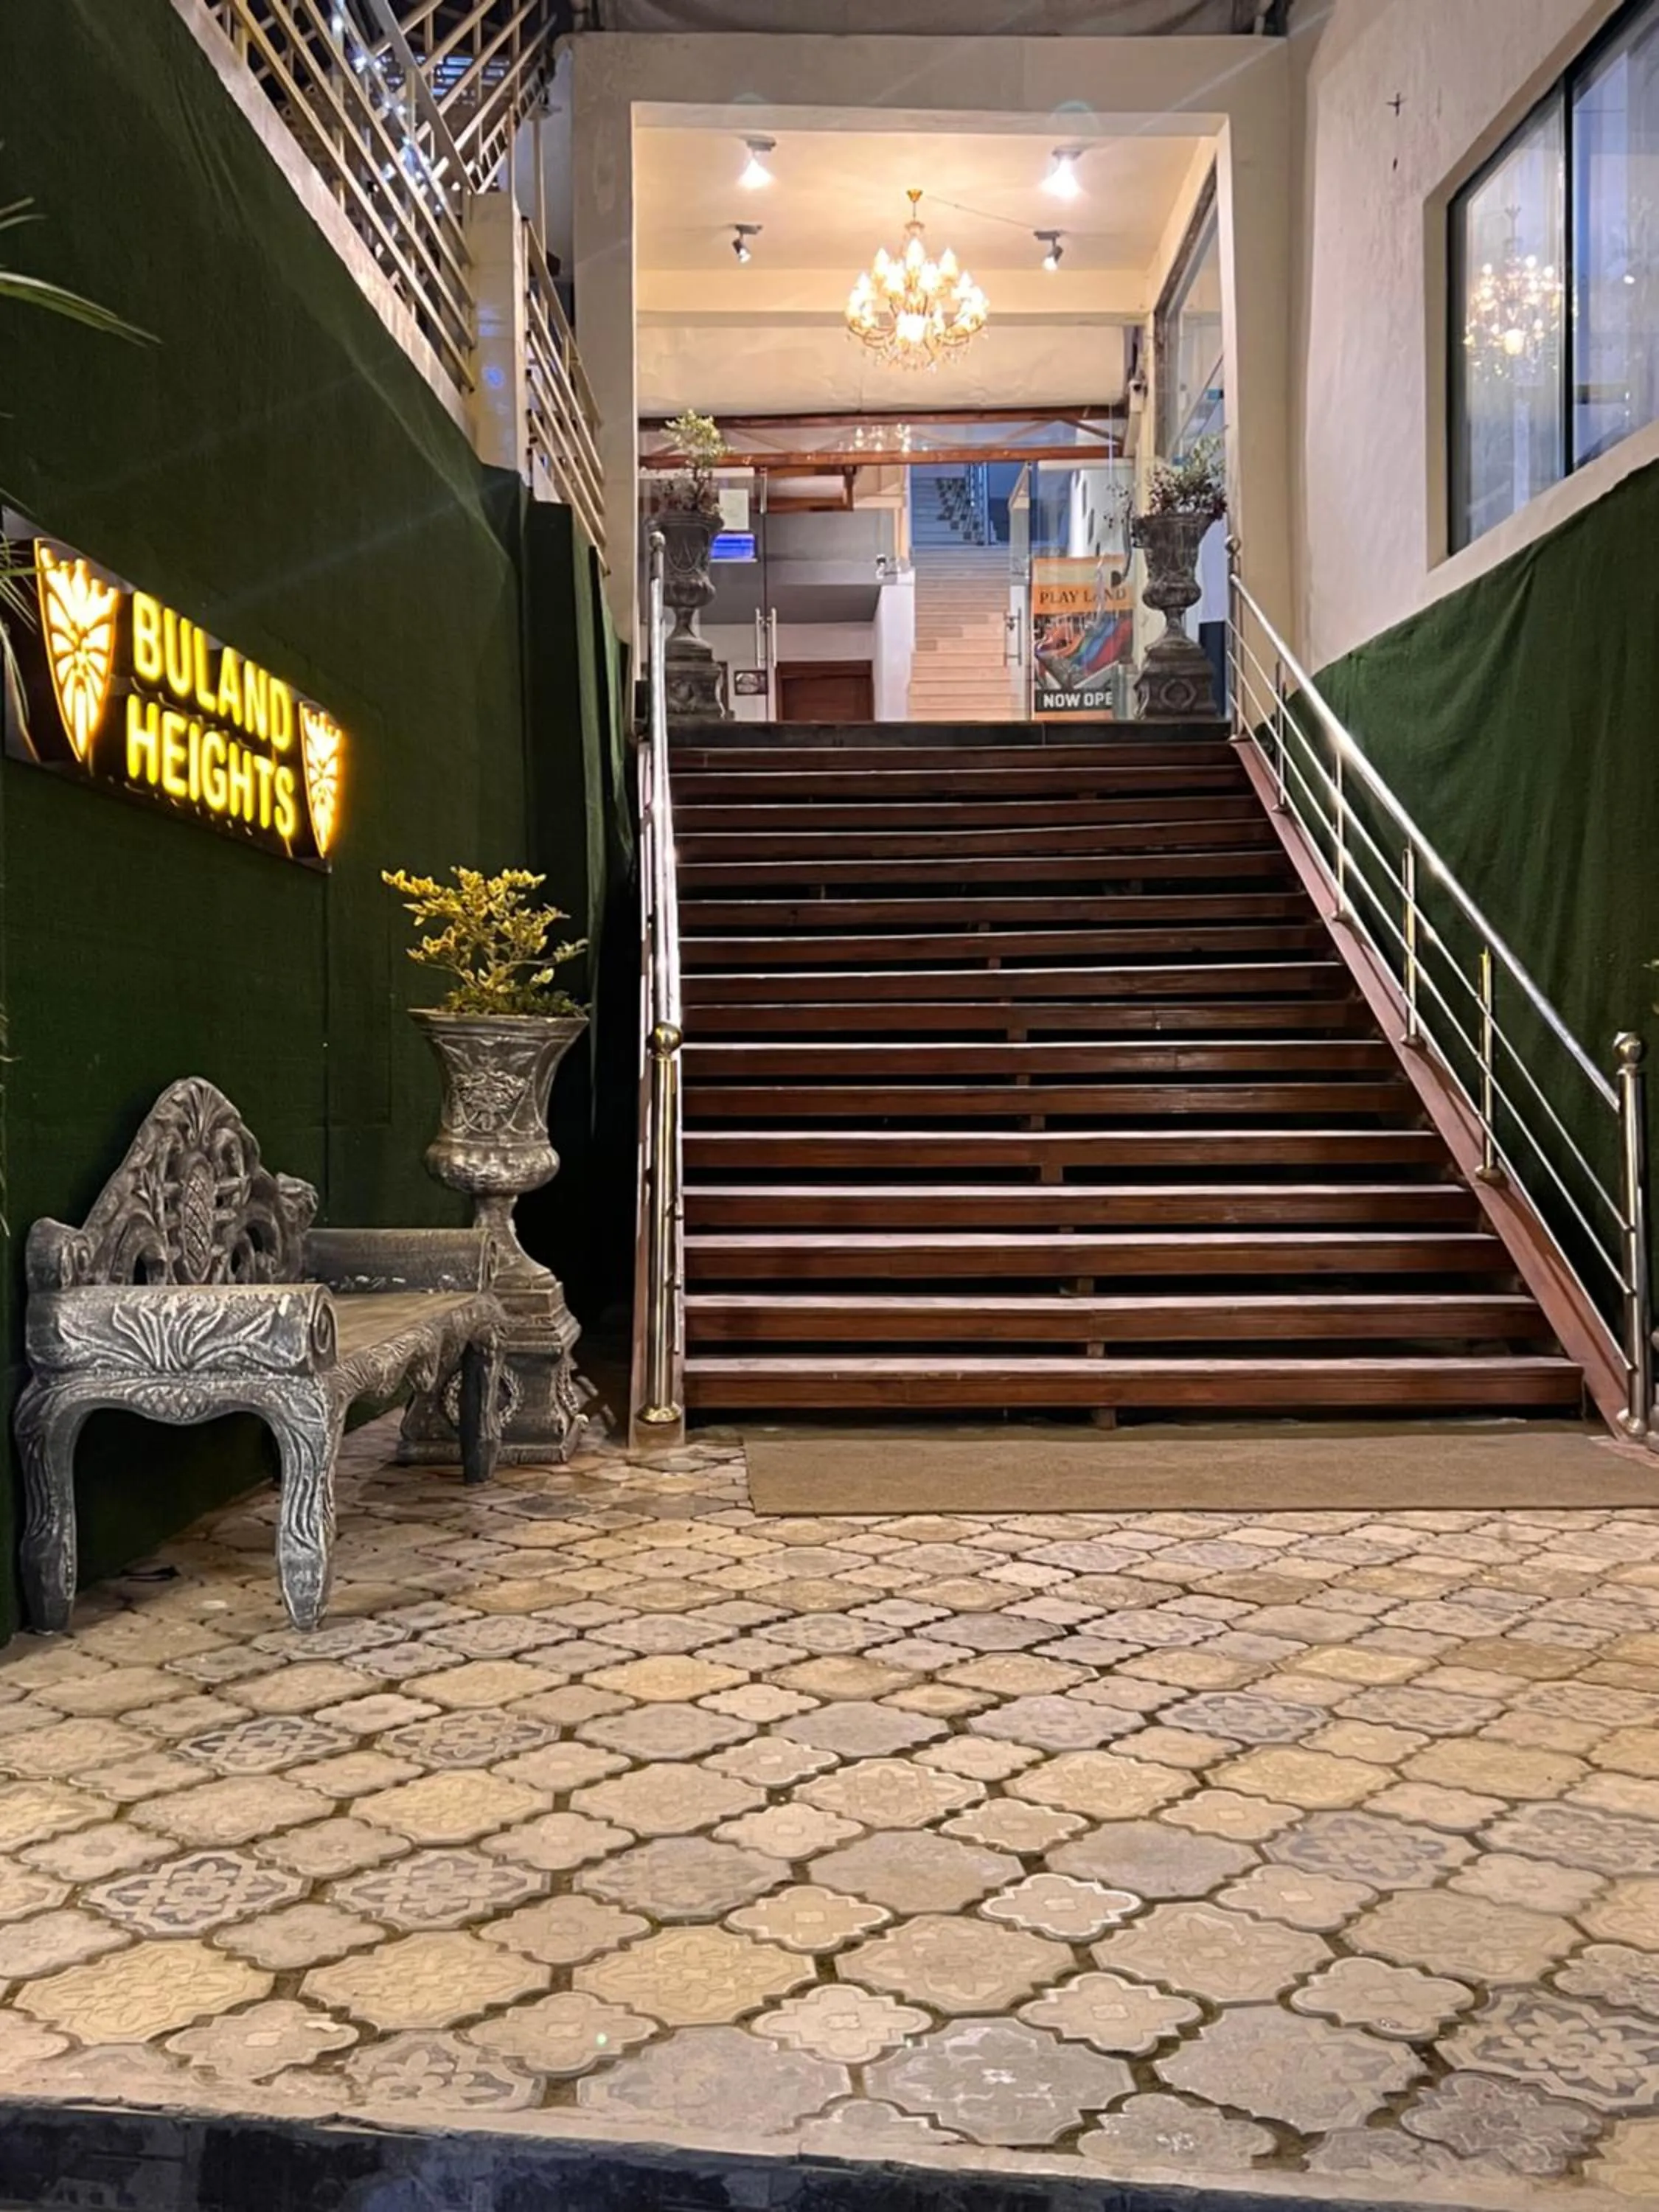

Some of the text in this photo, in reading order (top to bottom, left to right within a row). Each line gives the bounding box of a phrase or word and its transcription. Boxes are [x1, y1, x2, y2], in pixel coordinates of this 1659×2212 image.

[1040, 588, 1127, 605] PLAY LND
[133, 590, 293, 752] BULAND
[1043, 692, 1113, 708] NOW OPE
[126, 694, 296, 838] HEIGHTS
